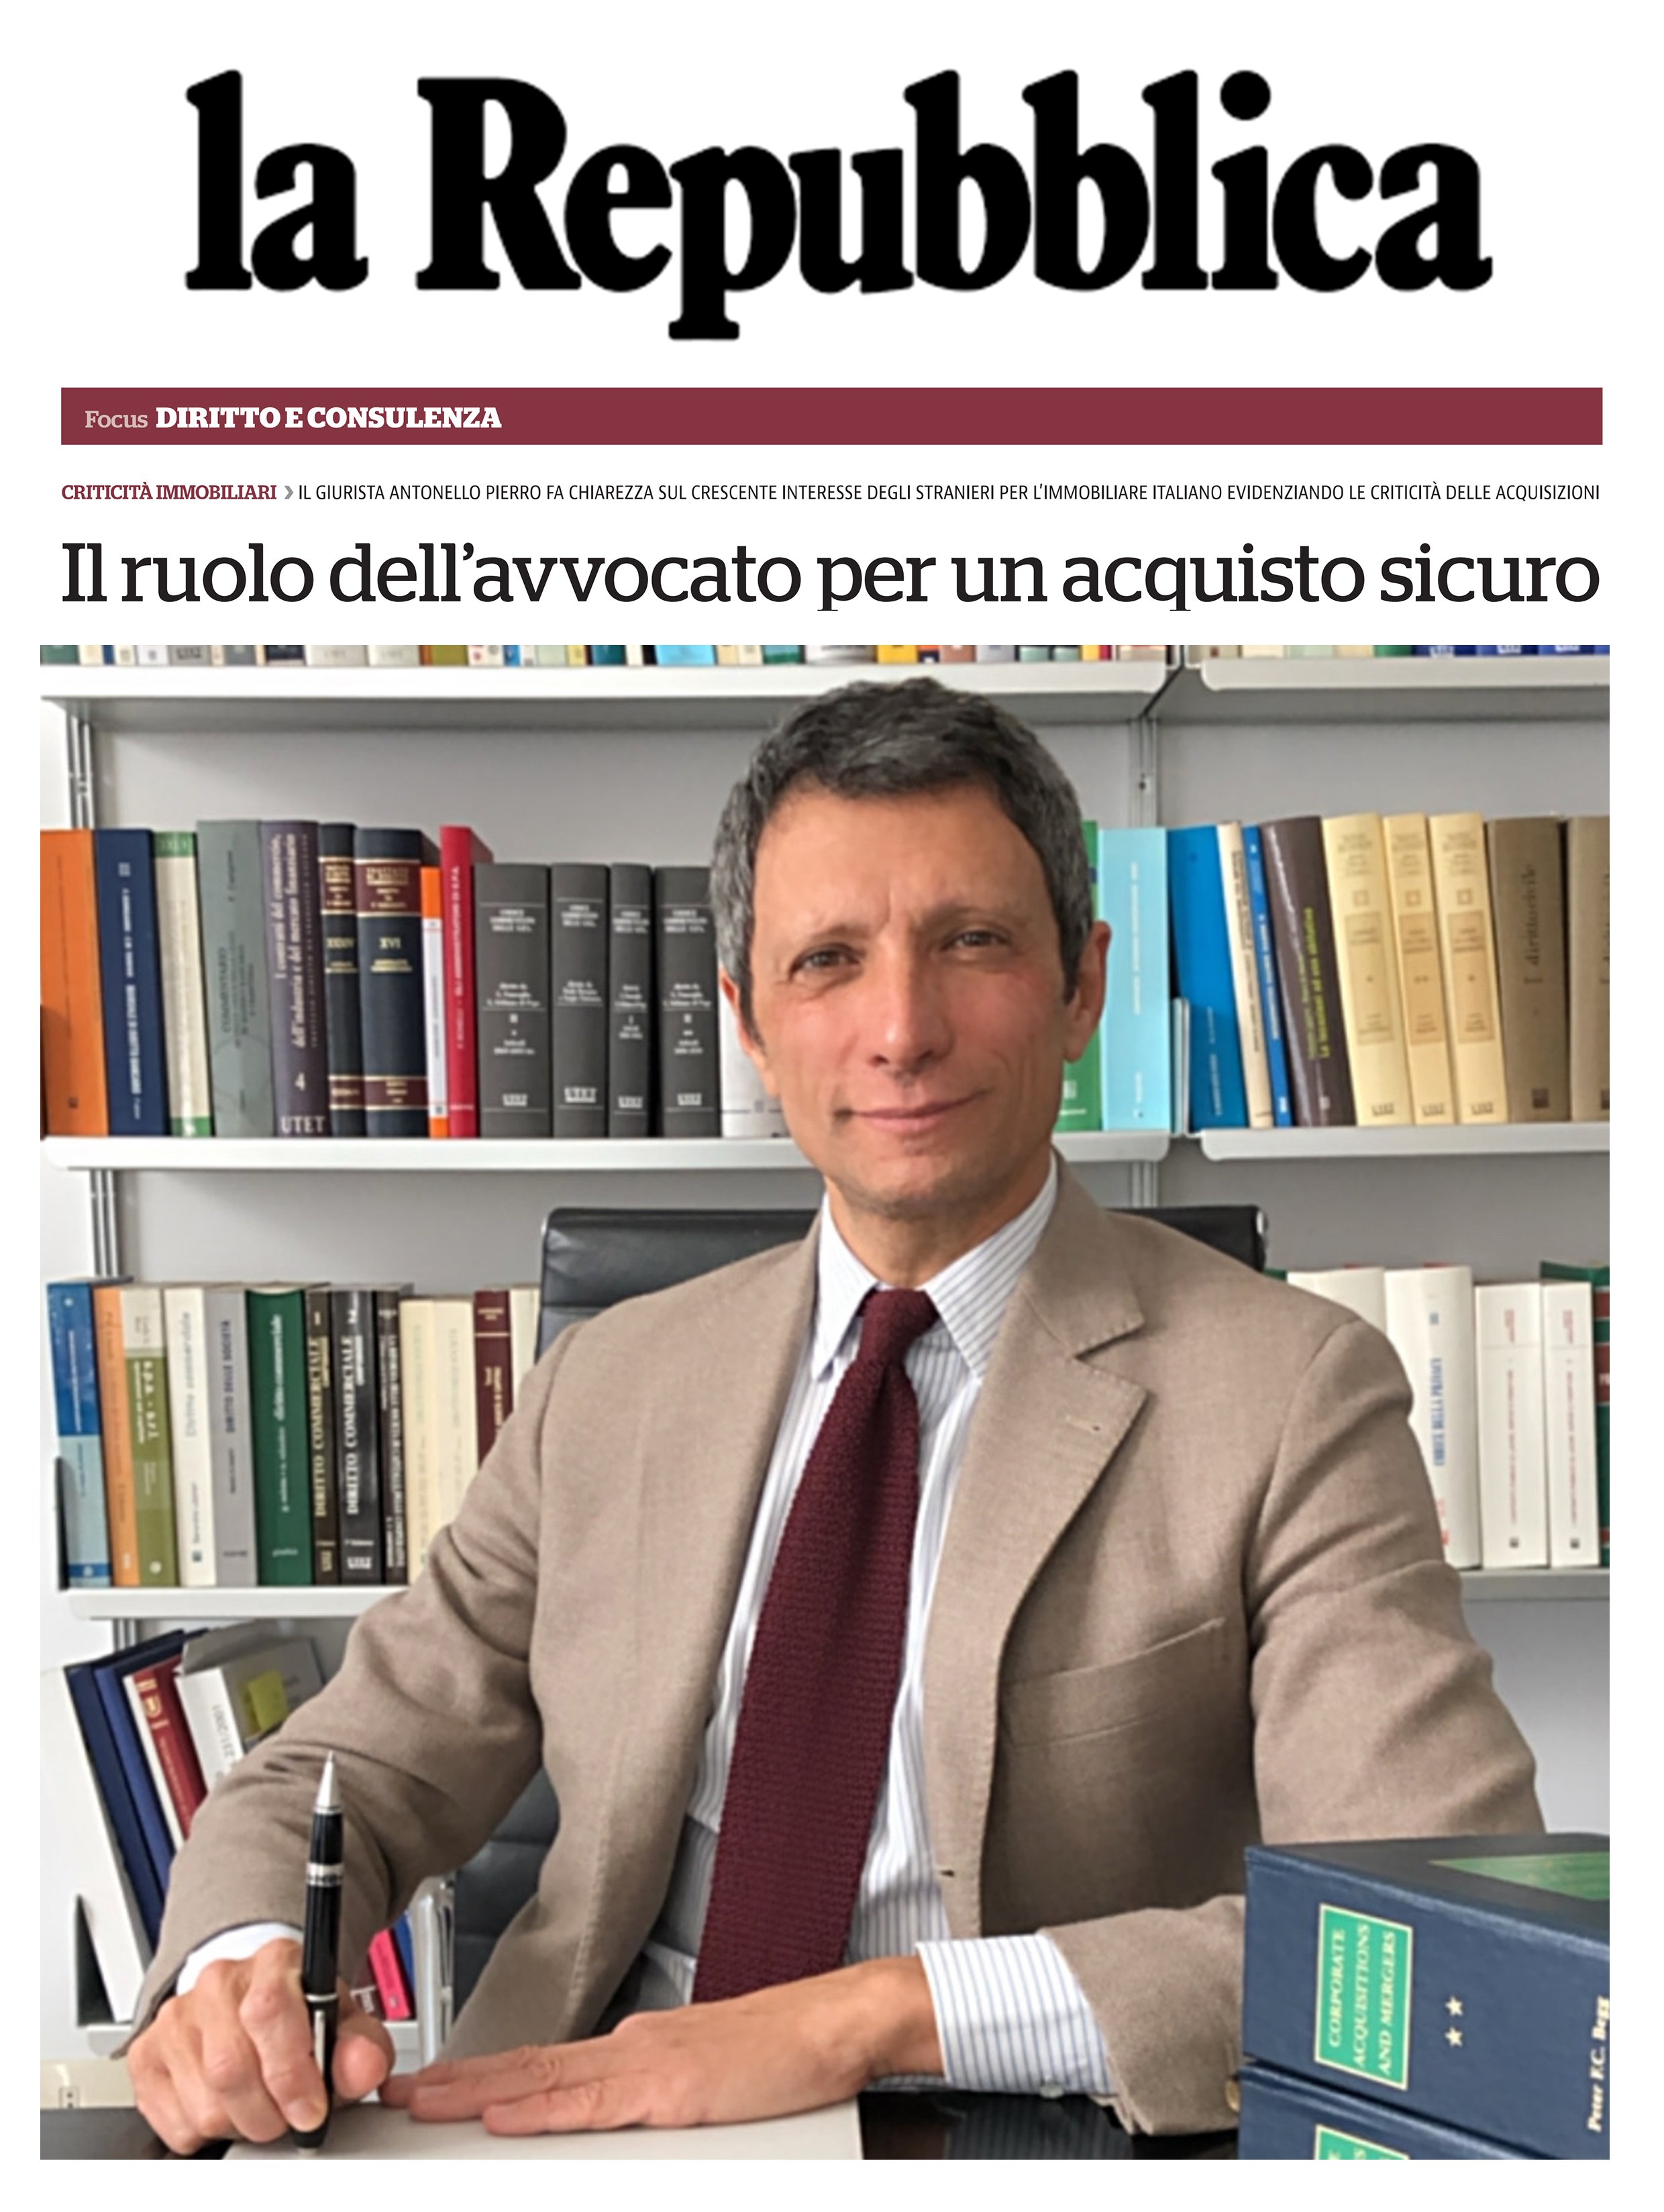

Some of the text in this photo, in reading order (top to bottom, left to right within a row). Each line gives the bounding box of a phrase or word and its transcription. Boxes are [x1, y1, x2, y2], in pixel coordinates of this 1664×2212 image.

[284, 834, 299, 895] finanziario
[270, 902, 284, 920] del
[289, 897, 301, 943] mercato
[287, 945, 302, 962] del
[295, 1072, 306, 1091] 4
[280, 1116, 325, 1134] UTET
[222, 1365, 233, 1393] DELLE
[224, 1396, 236, 1434] DIRITTO
[308, 1335, 326, 1517] DIRITTO COMMERCIALE
[341, 1335, 359, 1515] DIRITTO COMMERCIALE
[1329, 1928, 1345, 2048] CORPORATE
[1353, 1924, 1370, 2069] ACQUISITIONS
[1379, 1931, 1396, 2076] AND MERGERS
[1588, 2083, 1604, 2133] Peter
